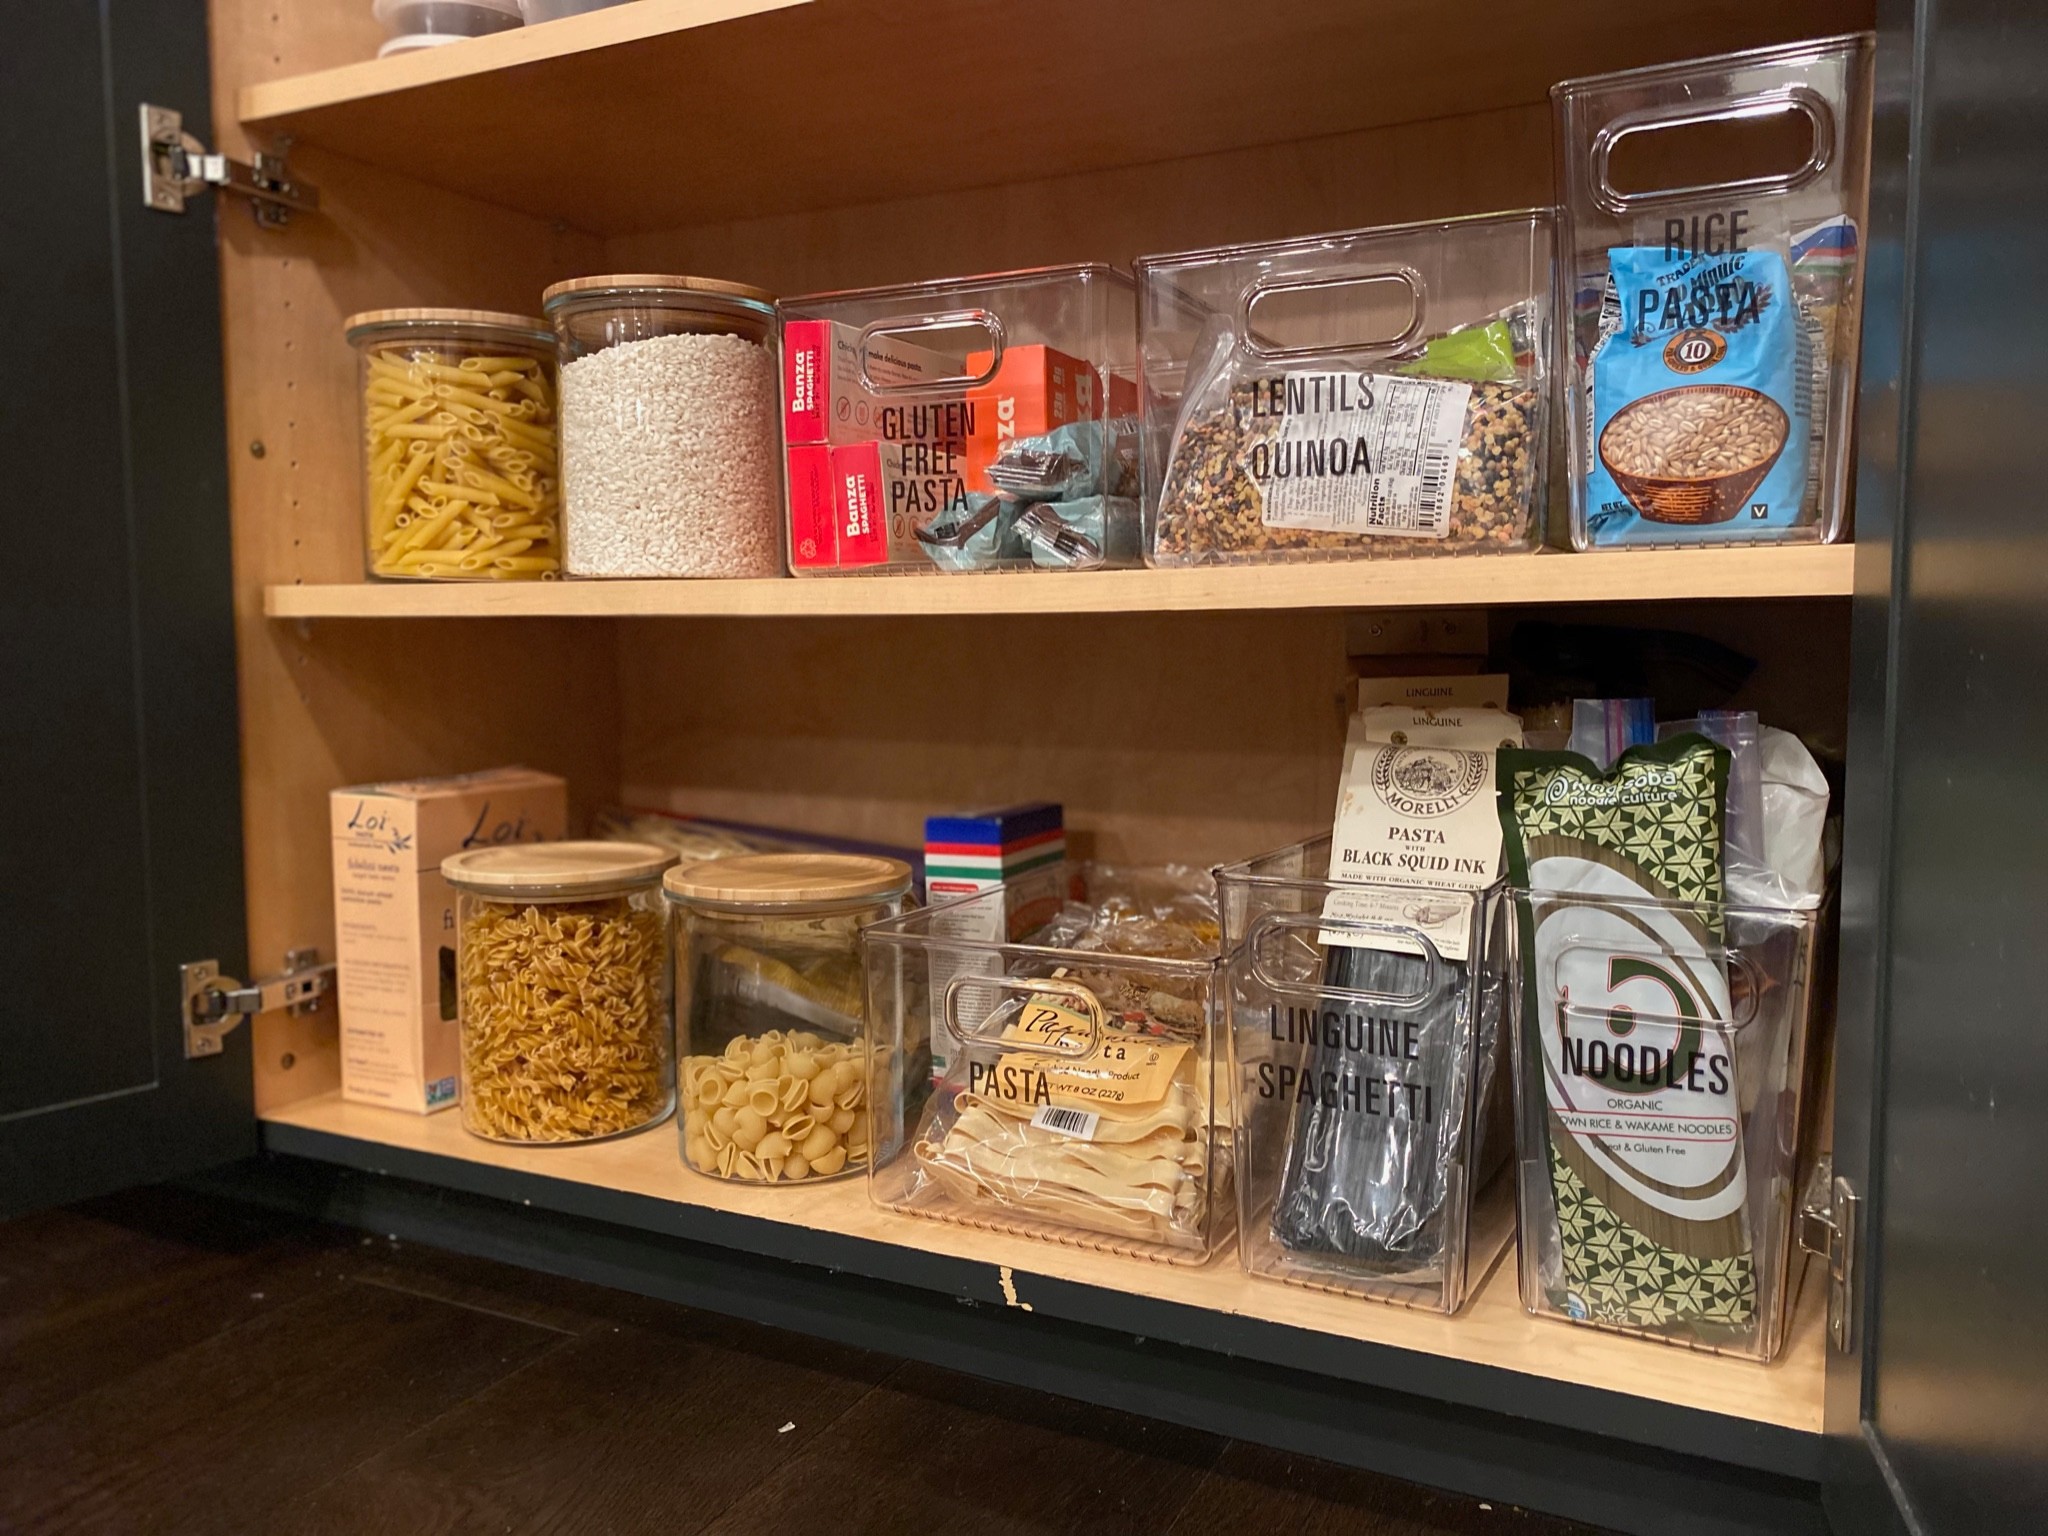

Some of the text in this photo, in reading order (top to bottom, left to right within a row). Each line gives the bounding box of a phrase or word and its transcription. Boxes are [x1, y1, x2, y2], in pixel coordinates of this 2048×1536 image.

[1665, 210, 1748, 262] RICE
[1638, 281, 1760, 331] PASTA
[868, 350, 883, 361] make
[884, 353, 907, 368] delicious
[907, 361, 922, 372] pasta
[1684, 343, 1706, 359] 10
[792, 351, 805, 412] Banza
[806, 351, 814, 411] SPAGHETTI
[1251, 372, 1374, 418] LENTILS
[882, 402, 975, 440] GLUTEN
[901, 441, 957, 476] FREE
[1251, 436, 1371, 481] QUINOA
[846, 475, 860, 538] Banza
[859, 474, 870, 535] SPAGHETTI
[892, 478, 969, 513] PASTA
[1369, 478, 1380, 526] Nutrition
[1376, 496, 1385, 526] Facts
[1406, 687, 1454, 697] LINGUINE
[1412, 717, 1463, 727] LINGUINE
[1623, 771, 1677, 790] soba
[1386, 792, 1460, 815] MORELLI
[1569, 791, 1678, 806] noodle culture
[1388, 826, 1446, 844] PASTA
[1405, 844, 1426, 852] WITH
[1342, 848, 1487, 874] BLACK SQUID INK
[1388, 877, 1424, 885] ORGANIC
[1427, 880, 1456, 888] WHEAT
[1458, 882, 1482, 890] GERM
[1271, 1004, 1419, 1060] LINGUINE
[1108, 1071, 1141, 1081] Product
[1562, 1036, 1729, 1095] NOODLES
[969, 1061, 1051, 1106] PASTA
[1081, 1086, 1097, 1094] OZ
[1098, 1090, 1125, 1101] (227g)
[1258, 1062, 1432, 1123] SPAGHETTI
[1607, 1098, 1663, 1111] ORGANIC
[1560, 1115, 1733, 1134] OWN RICE & WAKAME NOODLES
[1624, 1142, 1631, 1152] &
[1634, 1142, 1664, 1154] Gluten
[1666, 1145, 1686, 1155] Free
